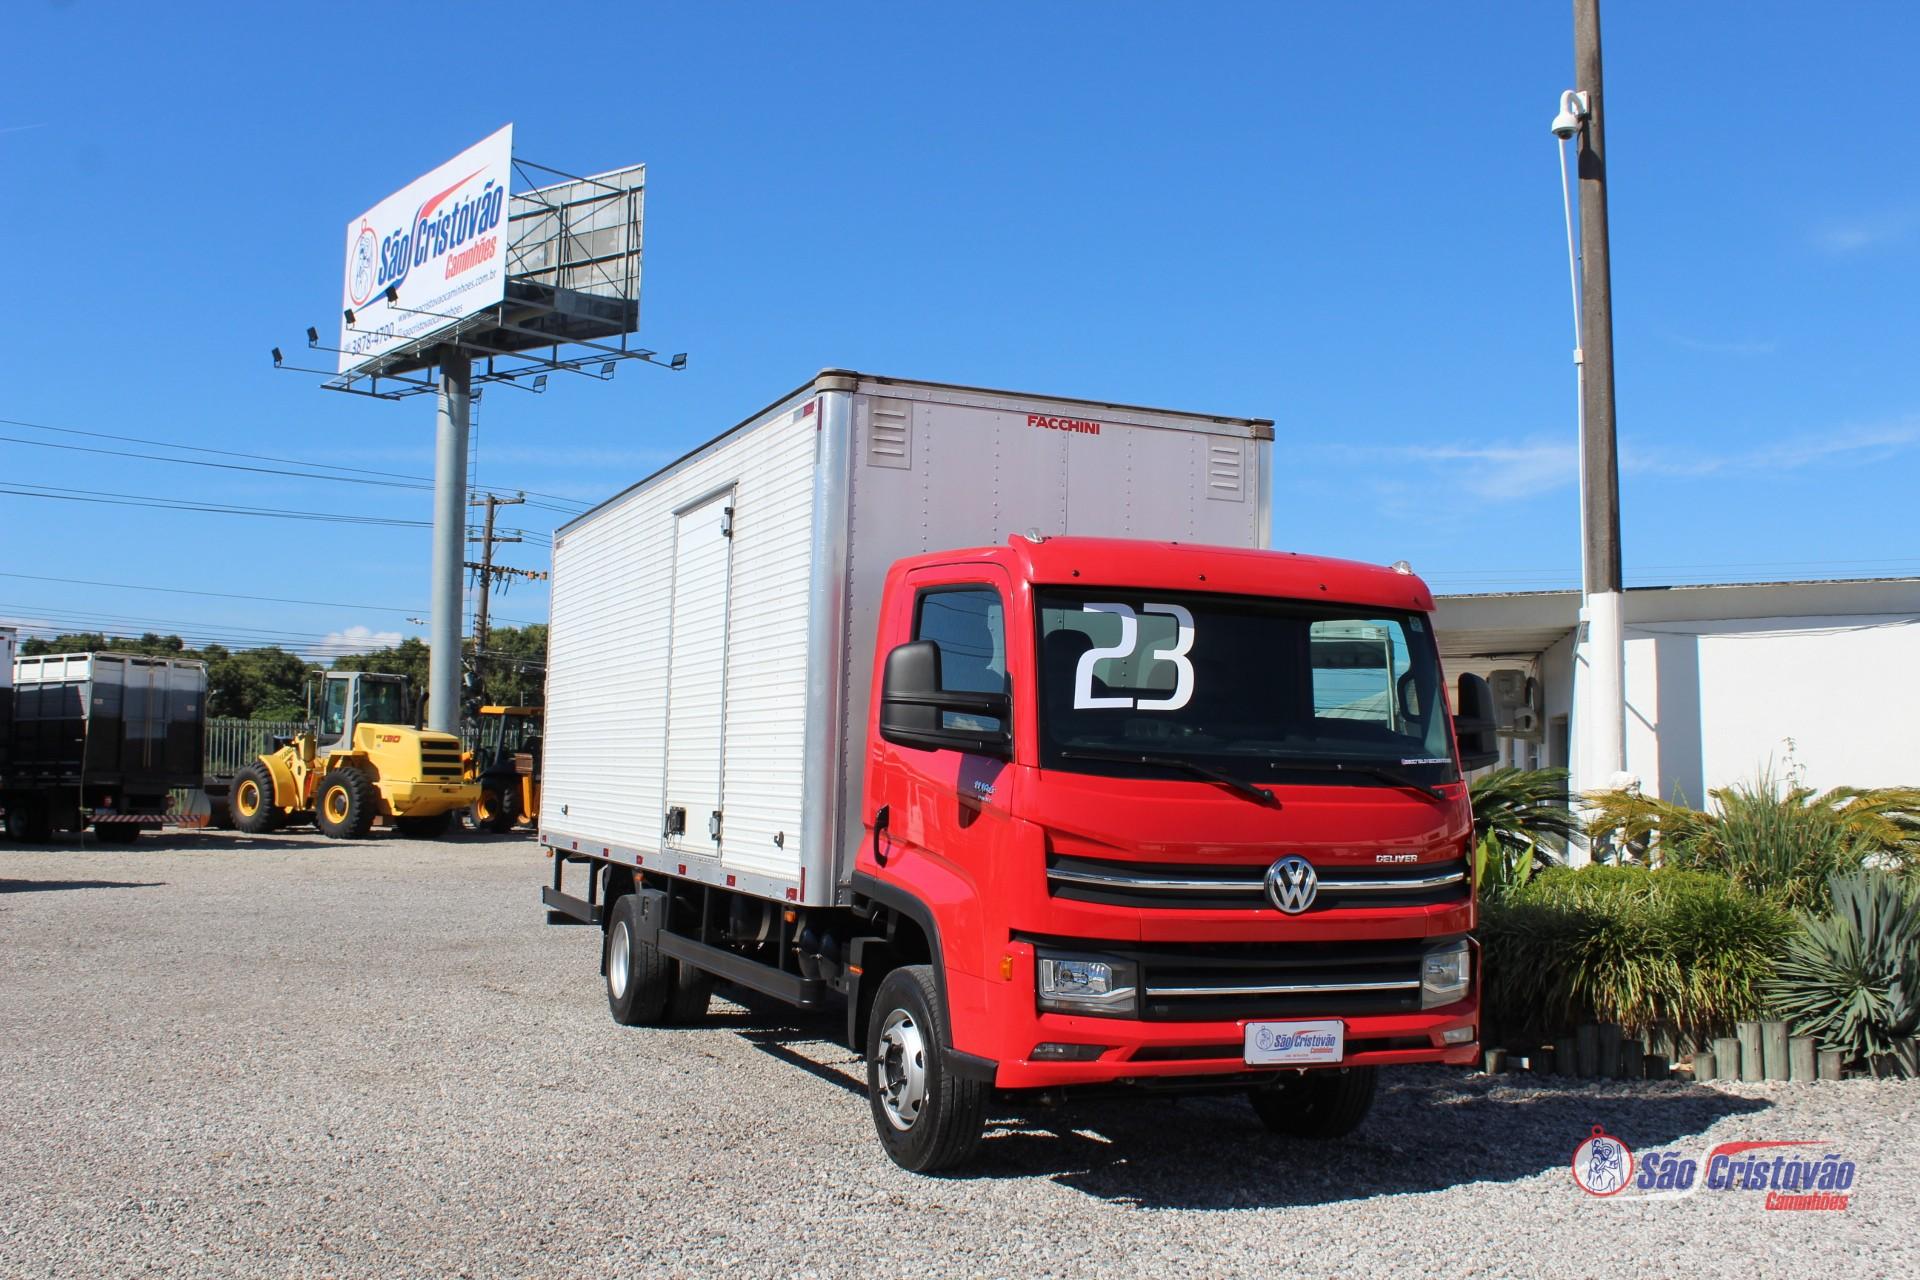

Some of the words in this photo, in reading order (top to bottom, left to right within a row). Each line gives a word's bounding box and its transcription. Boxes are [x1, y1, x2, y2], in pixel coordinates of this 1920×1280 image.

[378, 227, 409, 286] São
[414, 178, 503, 267] Cristóvão
[445, 235, 497, 280] Caminhões
[1027, 414, 1101, 435] FACCHINI
[1073, 602, 1195, 711] 23
[1274, 1034, 1292, 1048] São
